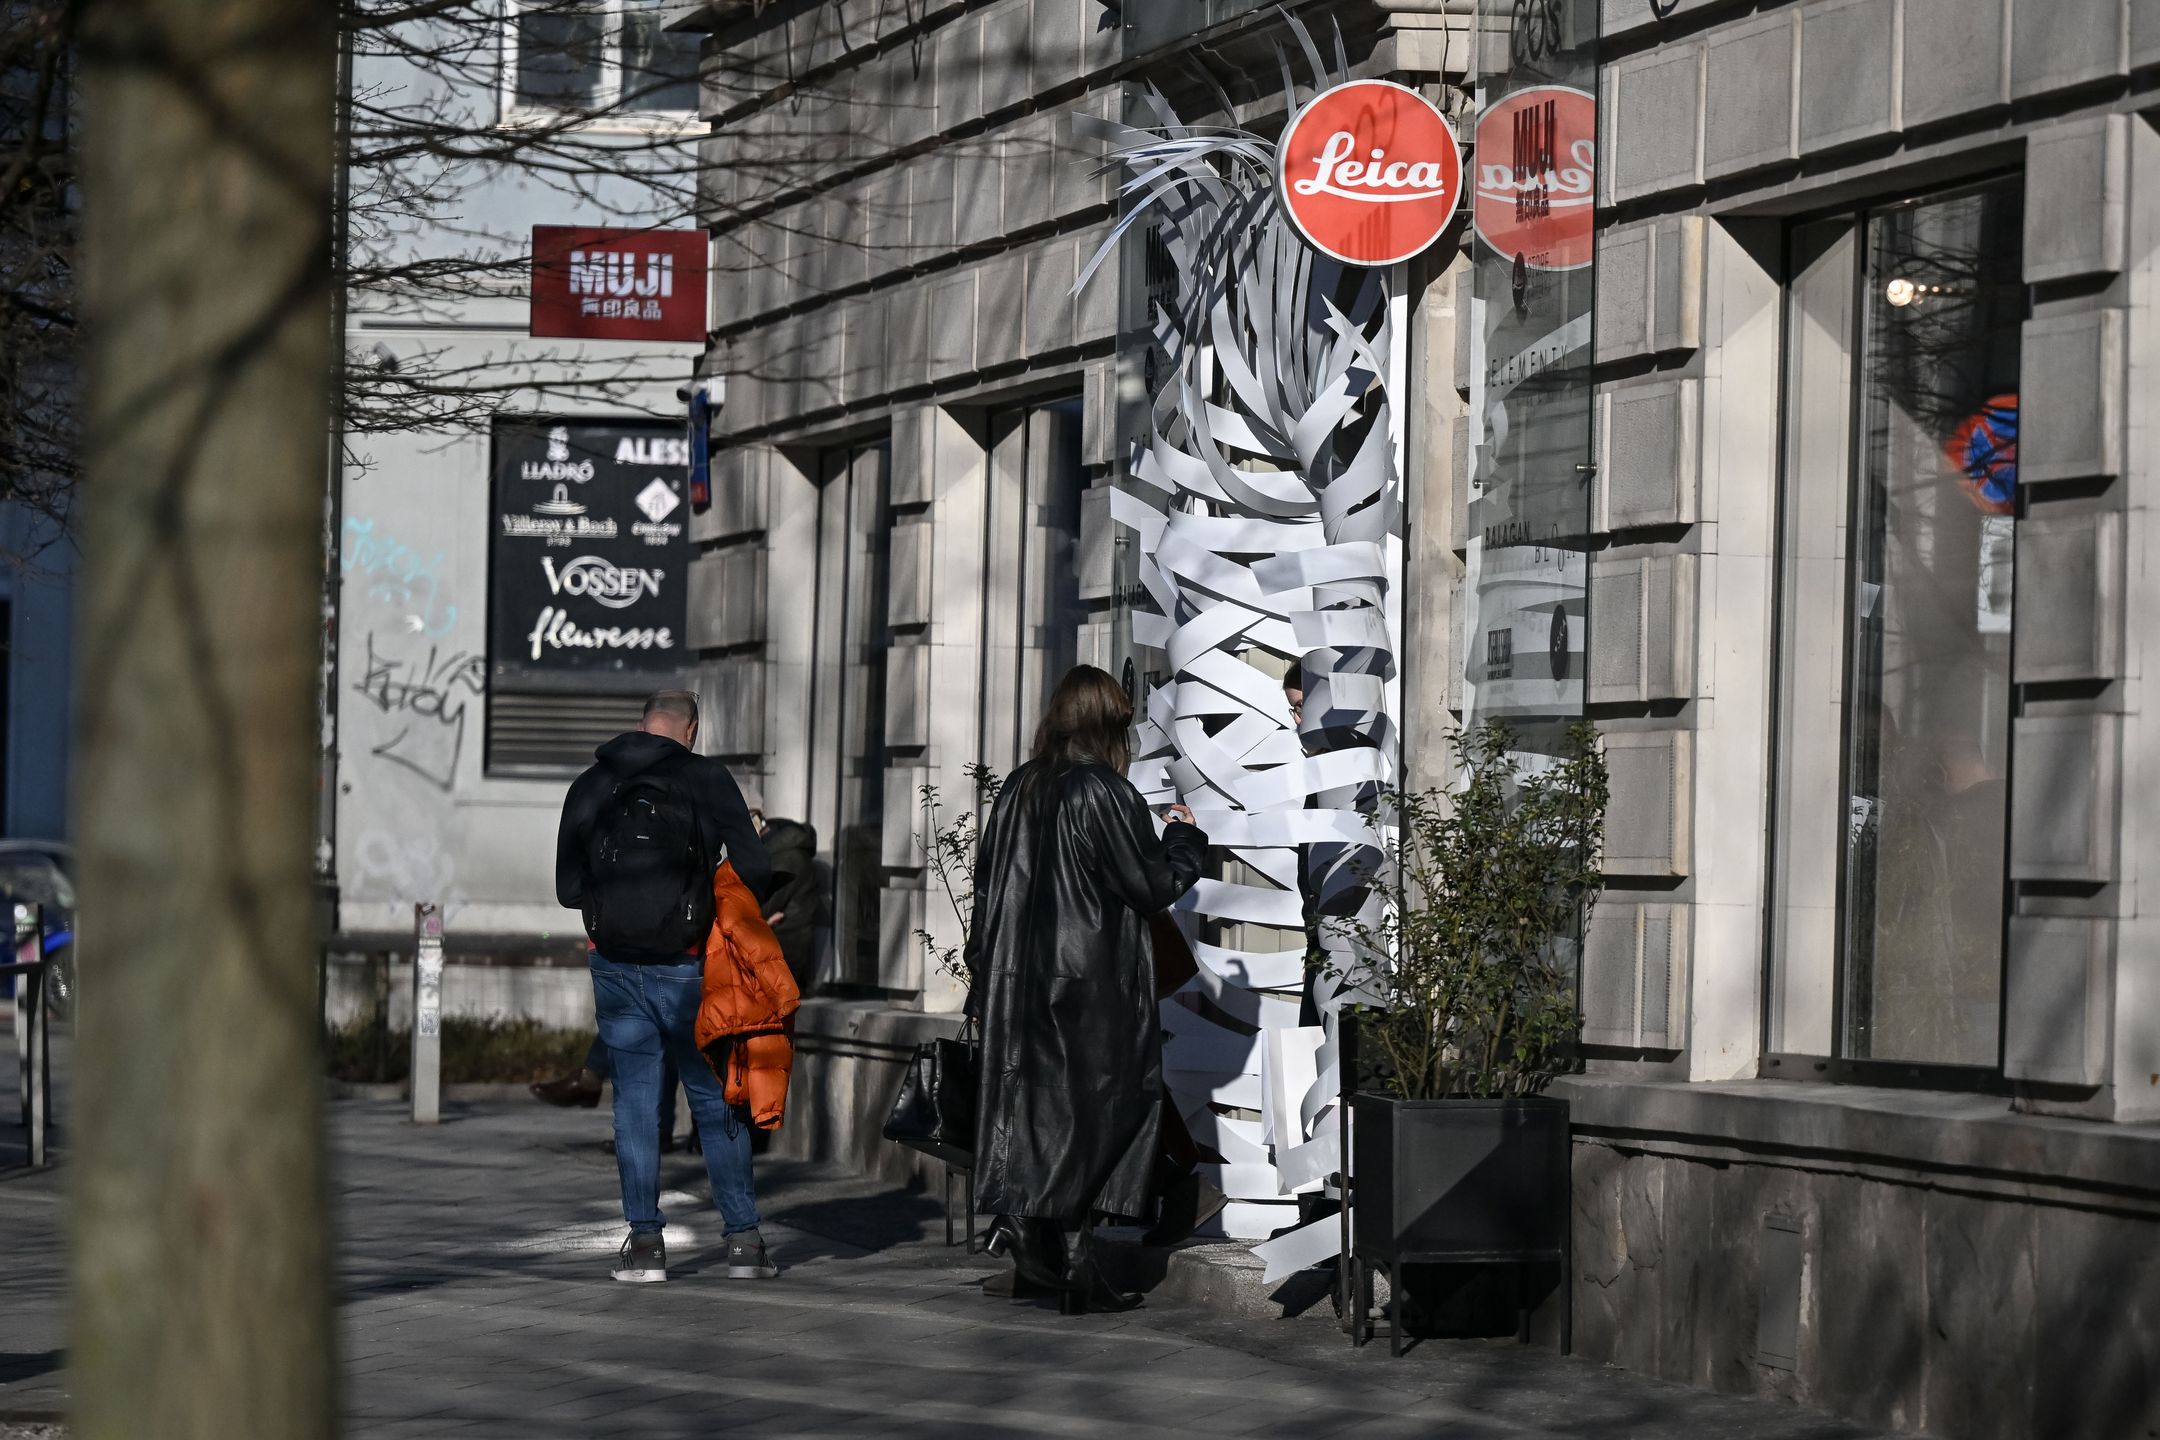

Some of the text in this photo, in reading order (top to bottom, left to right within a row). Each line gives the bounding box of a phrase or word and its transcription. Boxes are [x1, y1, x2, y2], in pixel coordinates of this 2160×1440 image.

[1294, 131, 1445, 202] Leica
[1512, 99, 1555, 182] MUJI
[570, 251, 673, 297] MUJI
[540, 556, 665, 608] VOSSEN
